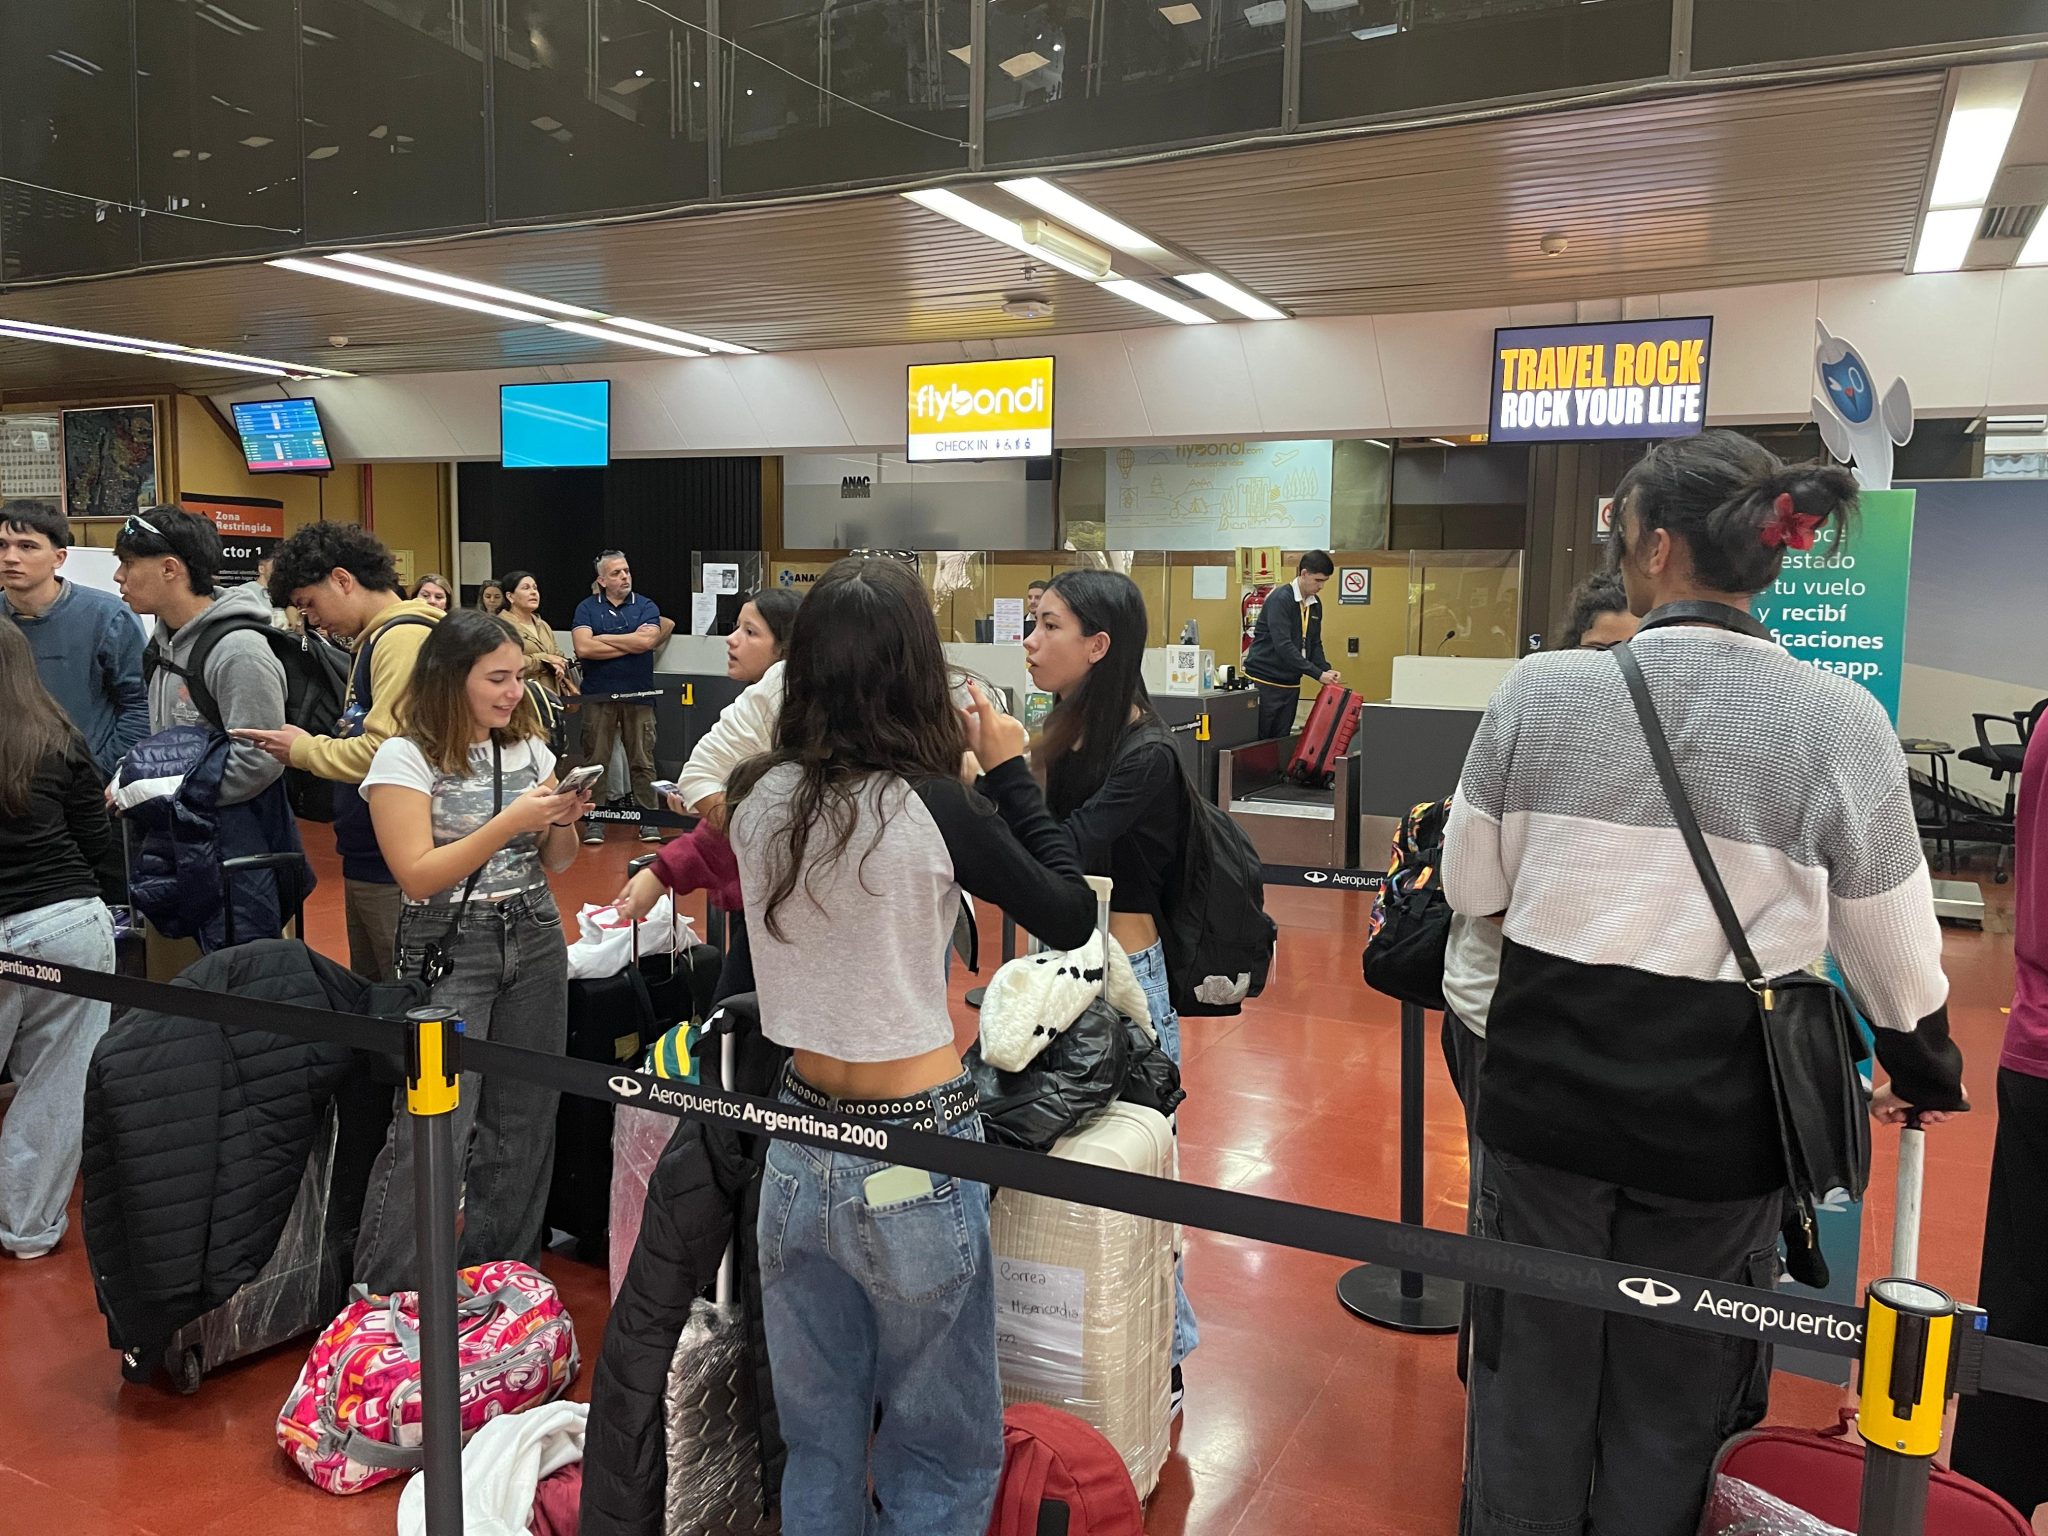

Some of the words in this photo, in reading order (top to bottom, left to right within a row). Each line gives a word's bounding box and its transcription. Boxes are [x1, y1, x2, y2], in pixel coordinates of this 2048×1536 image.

[1501, 344, 1606, 390] TRAVEL
[1613, 340, 1703, 387] ROCK
[916, 377, 1044, 422] flybondi
[1501, 390, 1575, 428] ROCK
[1576, 387, 1644, 426] YOUR
[1647, 385, 1701, 424] LIFE
[935, 440, 974, 452] CHECK
[977, 440, 988, 450] IN
[841, 475, 871, 489] ANAC
[215, 511, 240, 521] Zona
[216, 521, 272, 534] Restringida
[222, 546, 252, 558] ctor
[1781, 552, 1855, 570] estado
[1774, 579, 1796, 595] tu
[1803, 578, 1866, 596] vuelo
[1757, 607, 1771, 623] y
[1782, 604, 1848, 622] recibí
[1769, 628, 1884, 650] ficaciones
[621, 810, 641, 821] 2000
[1332, 873, 1384, 888] Aeropuert
[0, 959, 35, 979] gentina
[36, 964, 61, 983] 2000
[648, 1083, 741, 1119] Aeropuertos
[742, 1102, 838, 1141] Argentina
[840, 1122, 888, 1151] 2000
[1000, 1261, 1046, 1285] Correa
[1011, 1299, 1079, 1319] Misericordia
[1693, 1289, 1863, 1344] Aeropuertos
